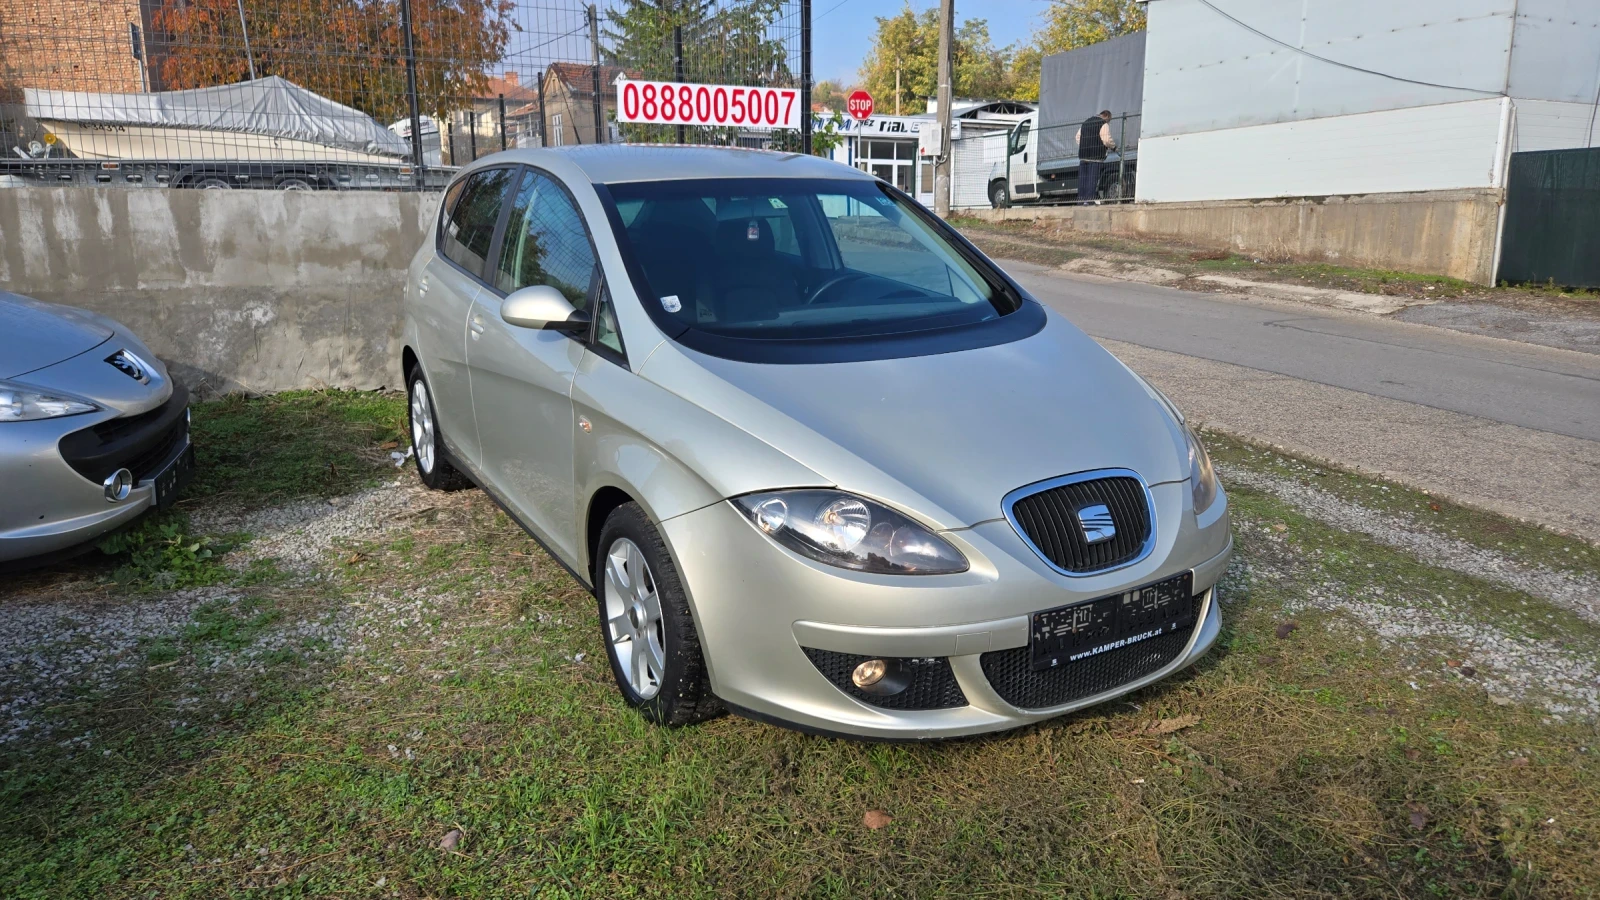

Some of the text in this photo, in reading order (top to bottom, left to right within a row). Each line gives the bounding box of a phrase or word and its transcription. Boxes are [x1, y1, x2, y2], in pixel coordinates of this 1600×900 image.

[623, 83, 796, 125] 0888005007
[850, 99, 872, 111] STOP
[1070, 627, 1163, 661] www.KAMPER-BRUCK.at
